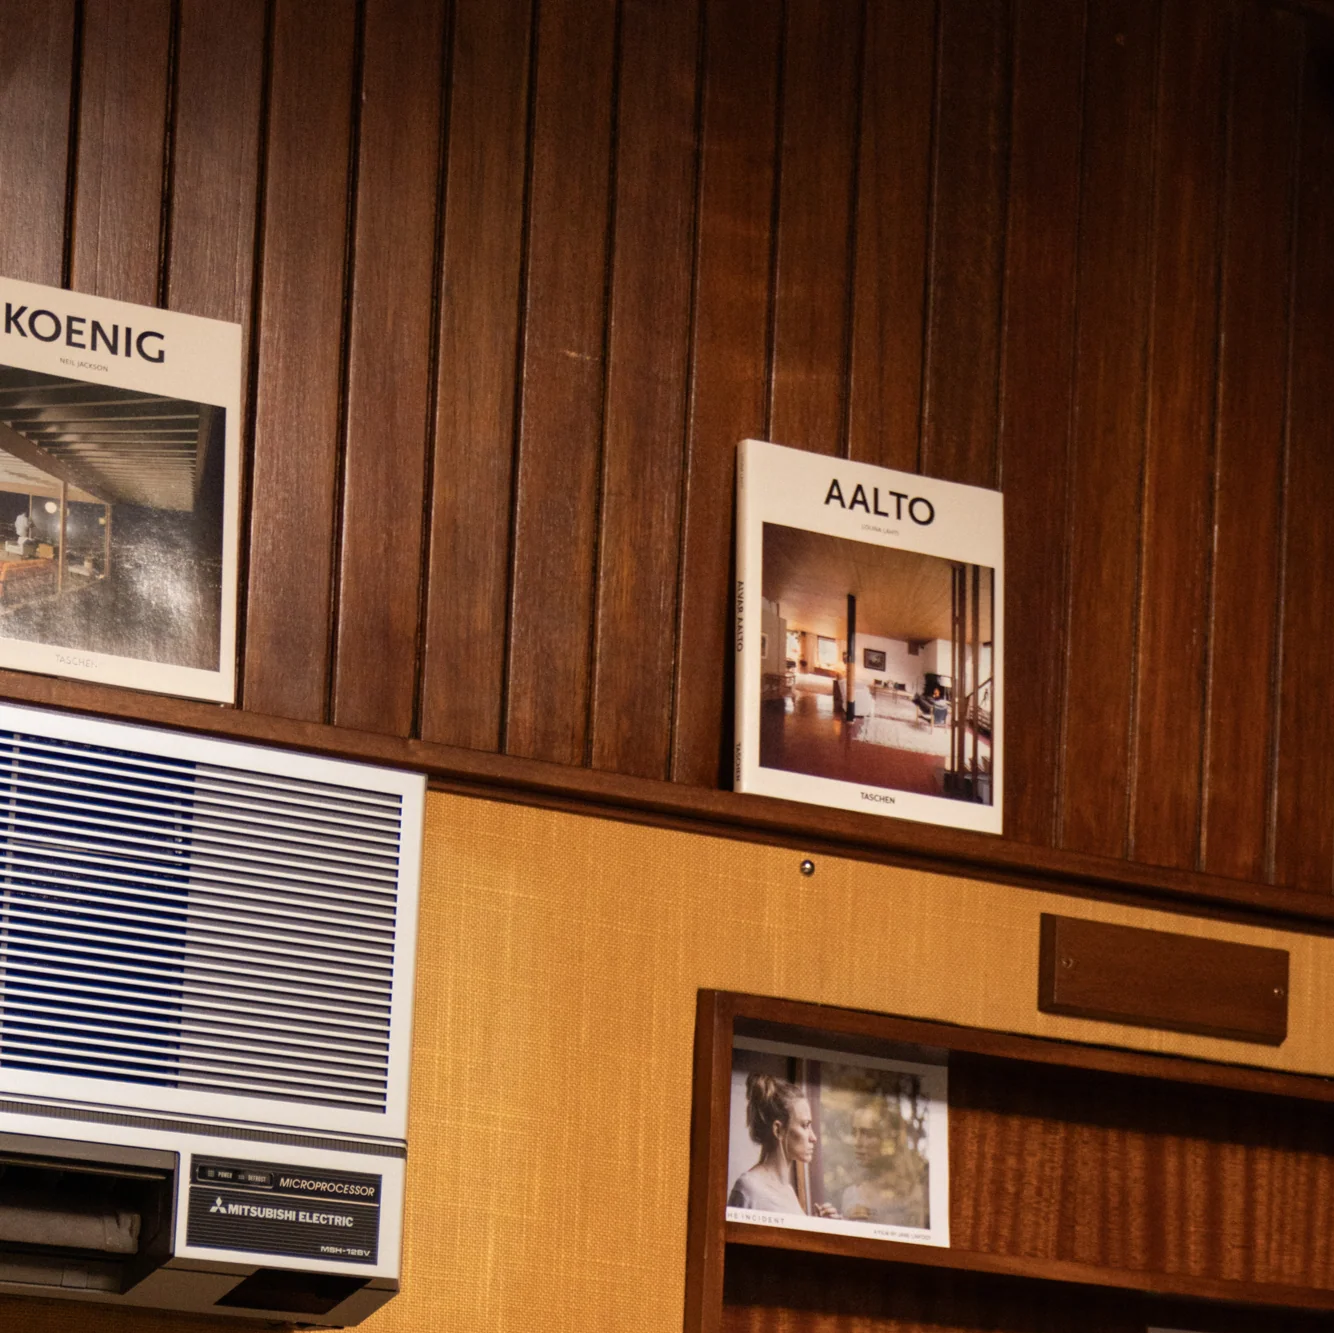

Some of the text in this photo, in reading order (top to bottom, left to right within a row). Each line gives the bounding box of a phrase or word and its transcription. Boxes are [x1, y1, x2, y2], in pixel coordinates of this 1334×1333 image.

[4, 302, 165, 364] KOENIG
[59, 357, 108, 372] NEIL JACKSON
[824, 478, 935, 526] AALTO
[736, 580, 745, 653] ALVAR AALTO
[55, 653, 98, 668] TASCHEN
[860, 791, 896, 804] TASCHEN
[217, 1171, 233, 1179] POWER
[279, 1177, 375, 1197] MICROPROCESSOR
[228, 1203, 354, 1228] MITSUBISHI ELECTRIC
[727, 1212, 785, 1225] HE INCIDENT
